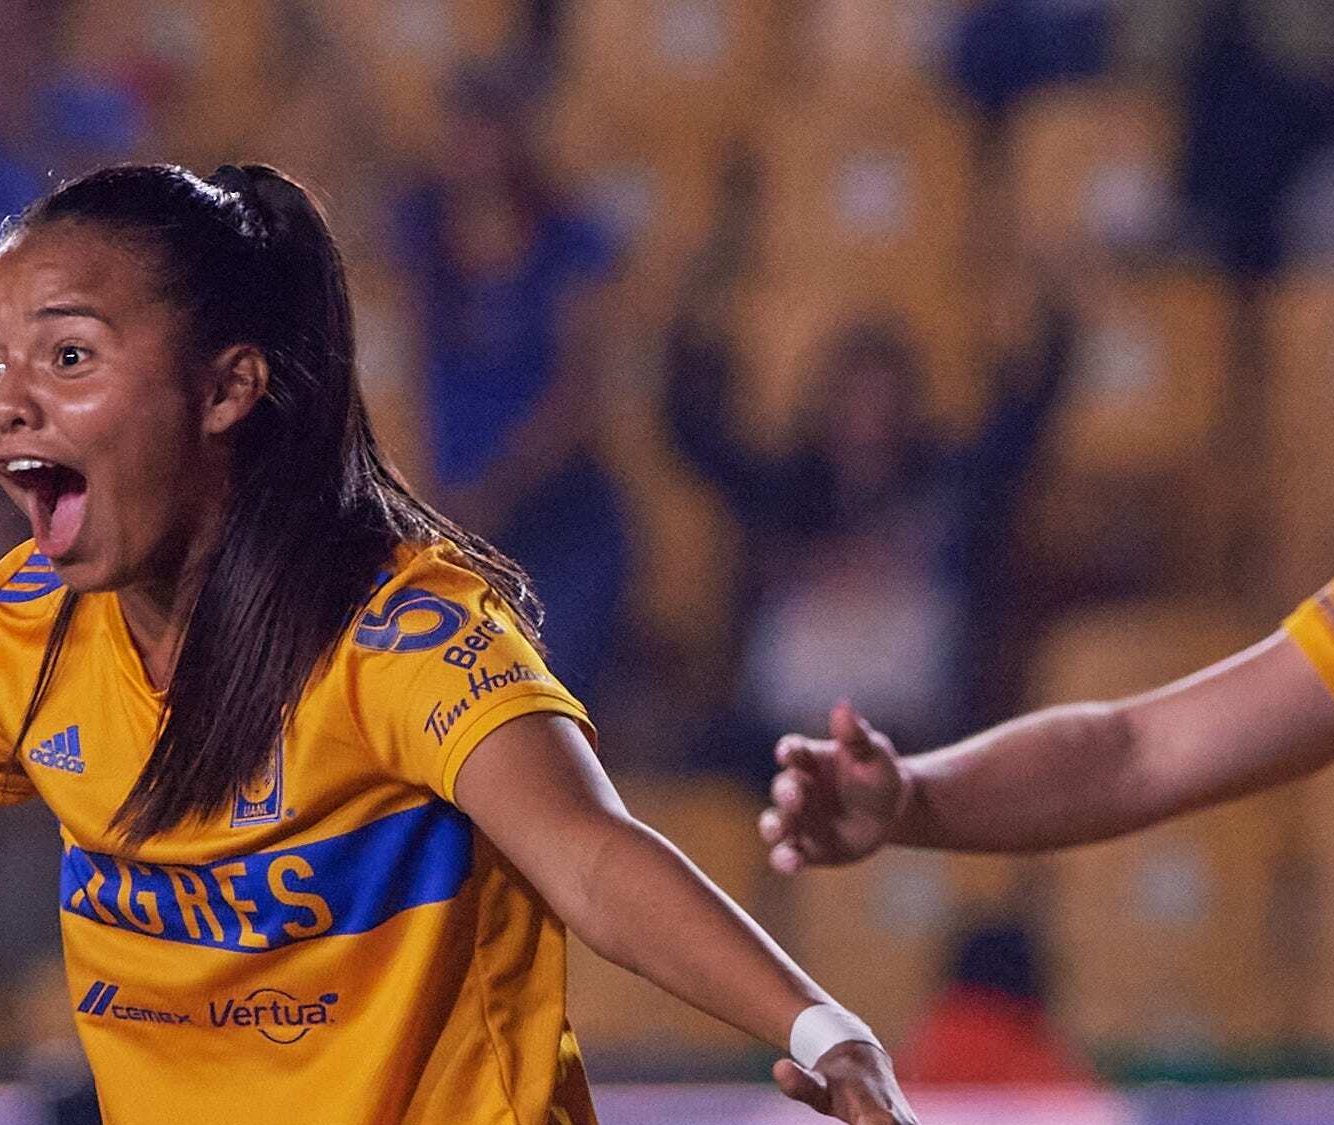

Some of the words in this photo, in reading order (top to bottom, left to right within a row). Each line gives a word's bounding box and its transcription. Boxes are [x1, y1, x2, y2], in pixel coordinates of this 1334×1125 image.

[423, 698, 471, 747] Tim
[29, 748, 86, 774] adidas
[71, 854, 333, 948] IGRES
[209, 999, 328, 1027] Vertua
